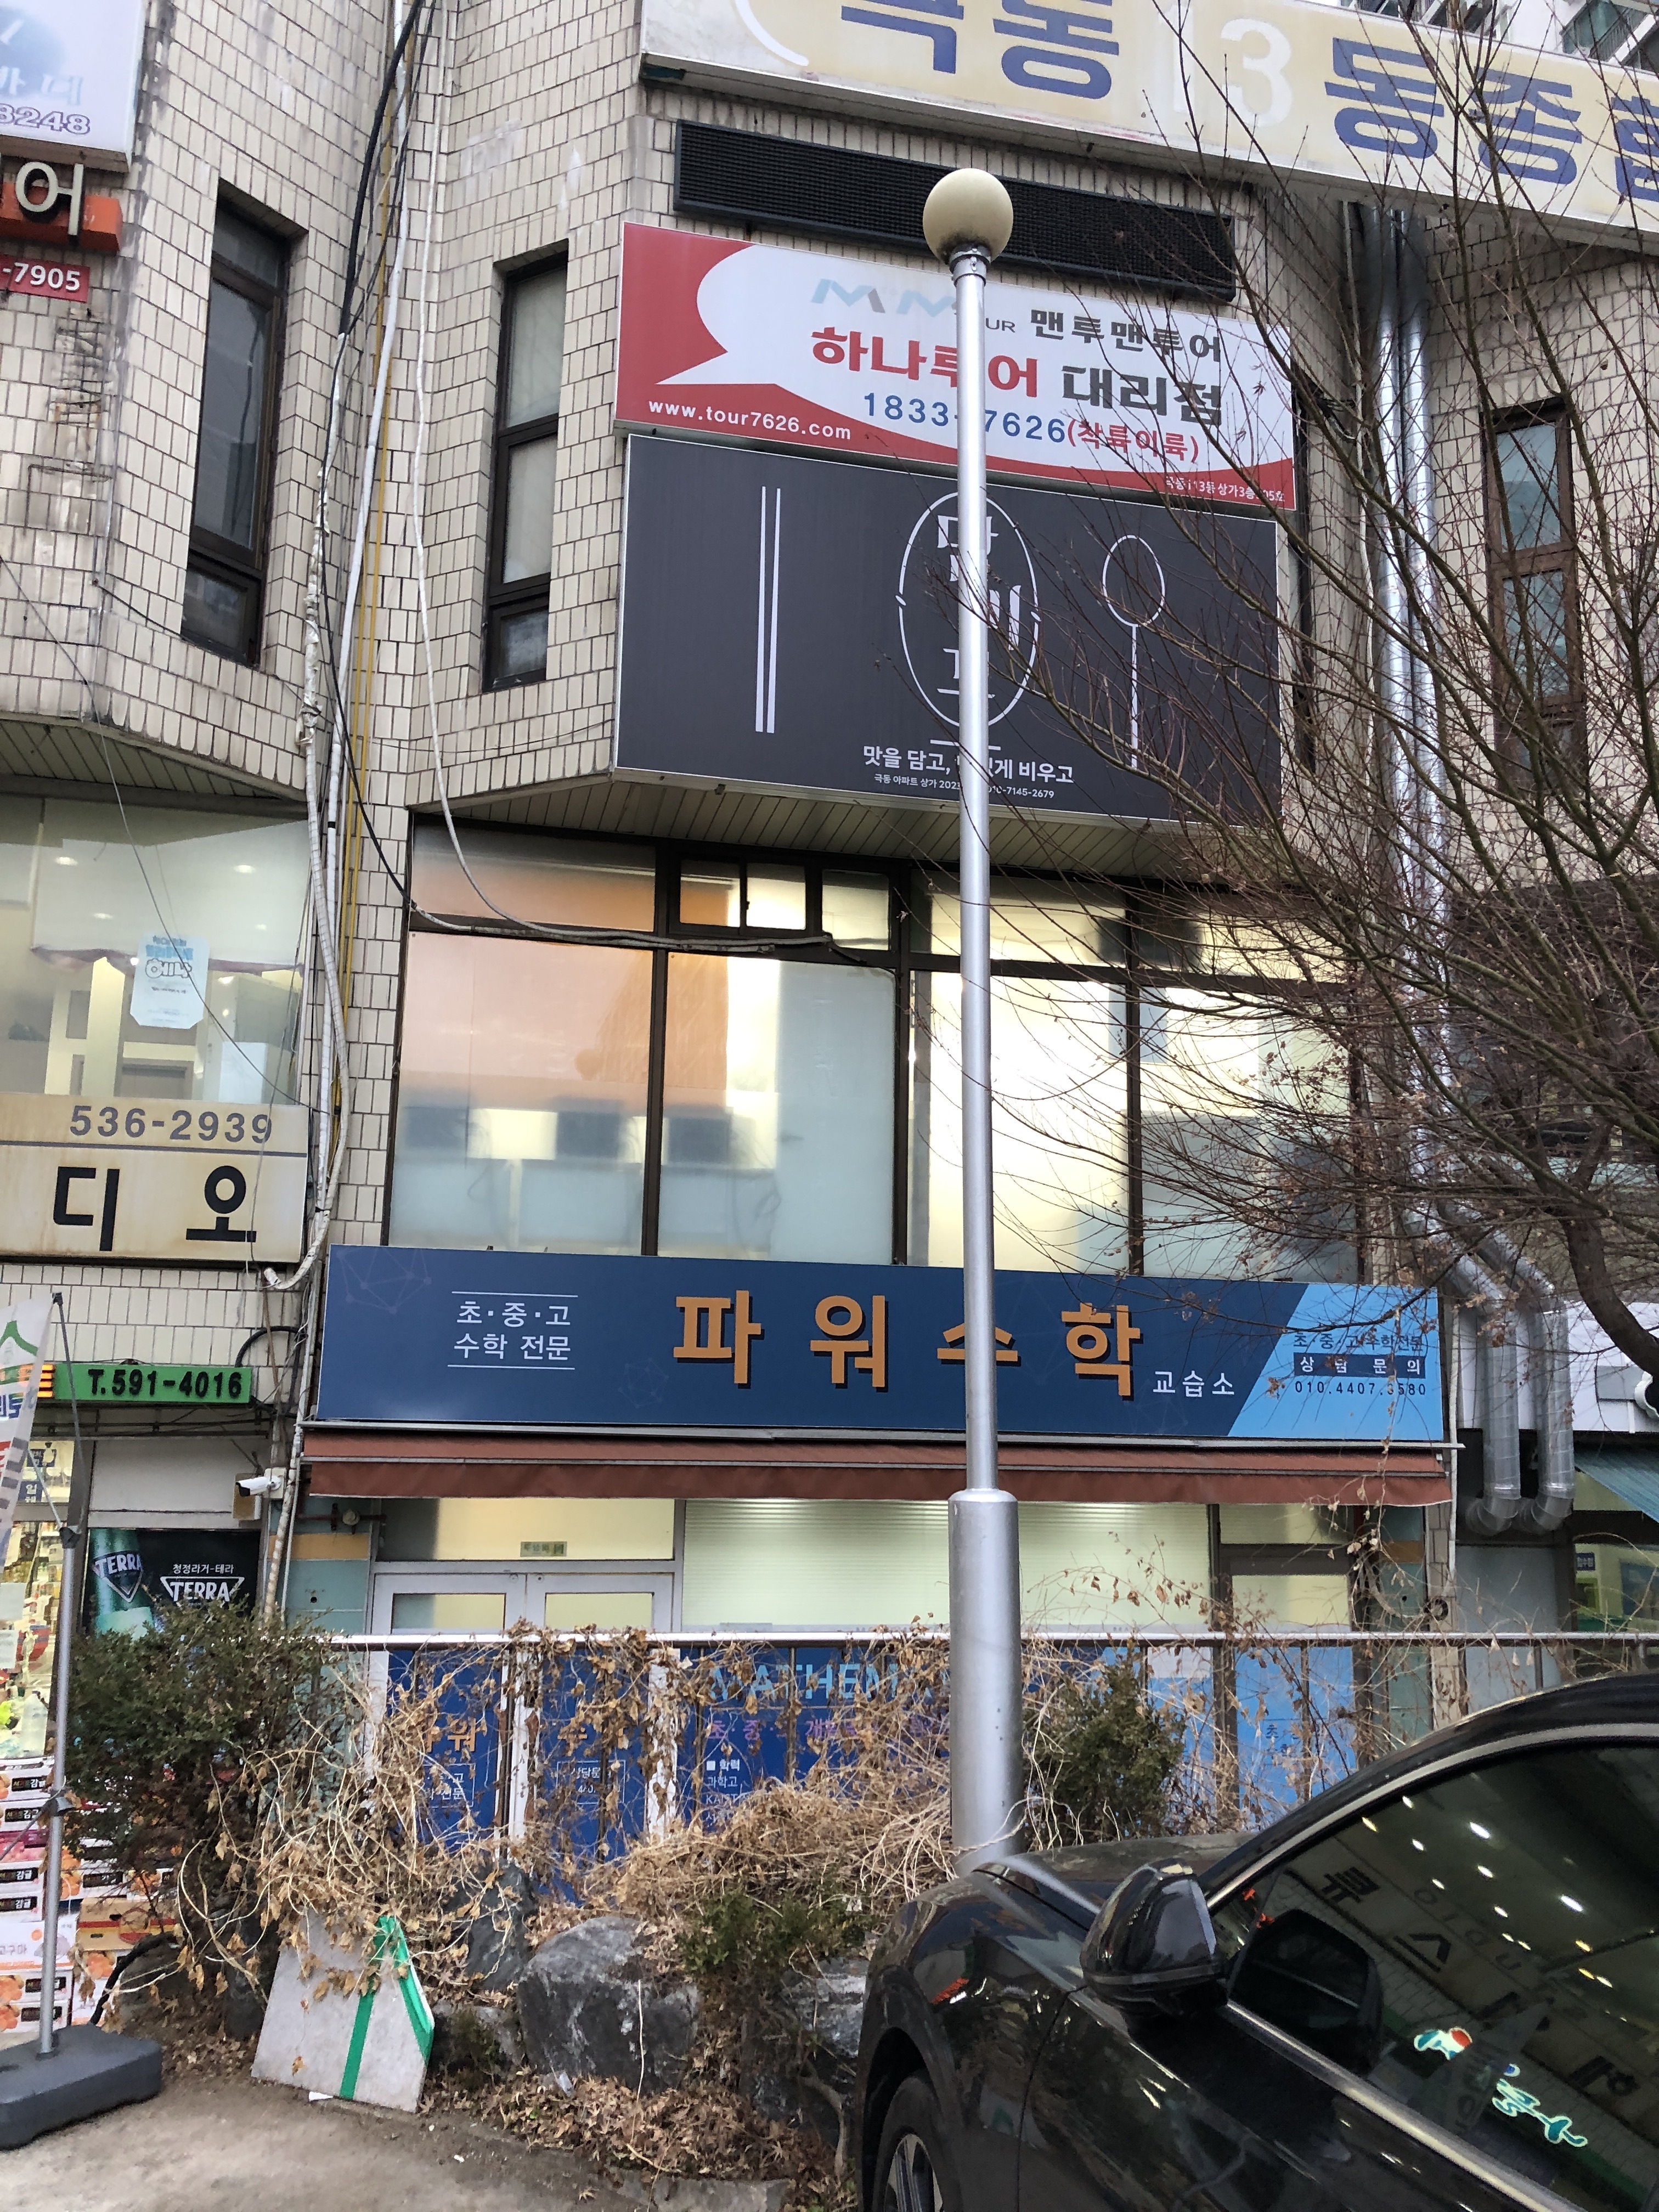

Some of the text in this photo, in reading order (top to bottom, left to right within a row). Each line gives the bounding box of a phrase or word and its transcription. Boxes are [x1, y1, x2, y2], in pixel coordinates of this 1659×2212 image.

[15, 161, 84, 236] 어
[1030, 309, 1221, 363] 맨투맨투어
[1062, 365, 1222, 427] 대리점
[648, 400, 851, 441] www.tour7626.com
[863, 745, 902, 769] 맛을
[907, 749, 951, 776] 담고,
[1019, 760, 1074, 784] 비우고
[874, 773, 891, 784] 극동
[893, 775, 918, 786] 아파트
[920, 777, 938, 788] 상가
[70, 1105, 273, 1144] 536-2939
[454, 1333, 572, 1362] 수학 전문
[1153, 1370, 1235, 1398] 교습소
[95, 1553, 143, 1577] TERRA
[170, 1581, 230, 1602] TERRA
